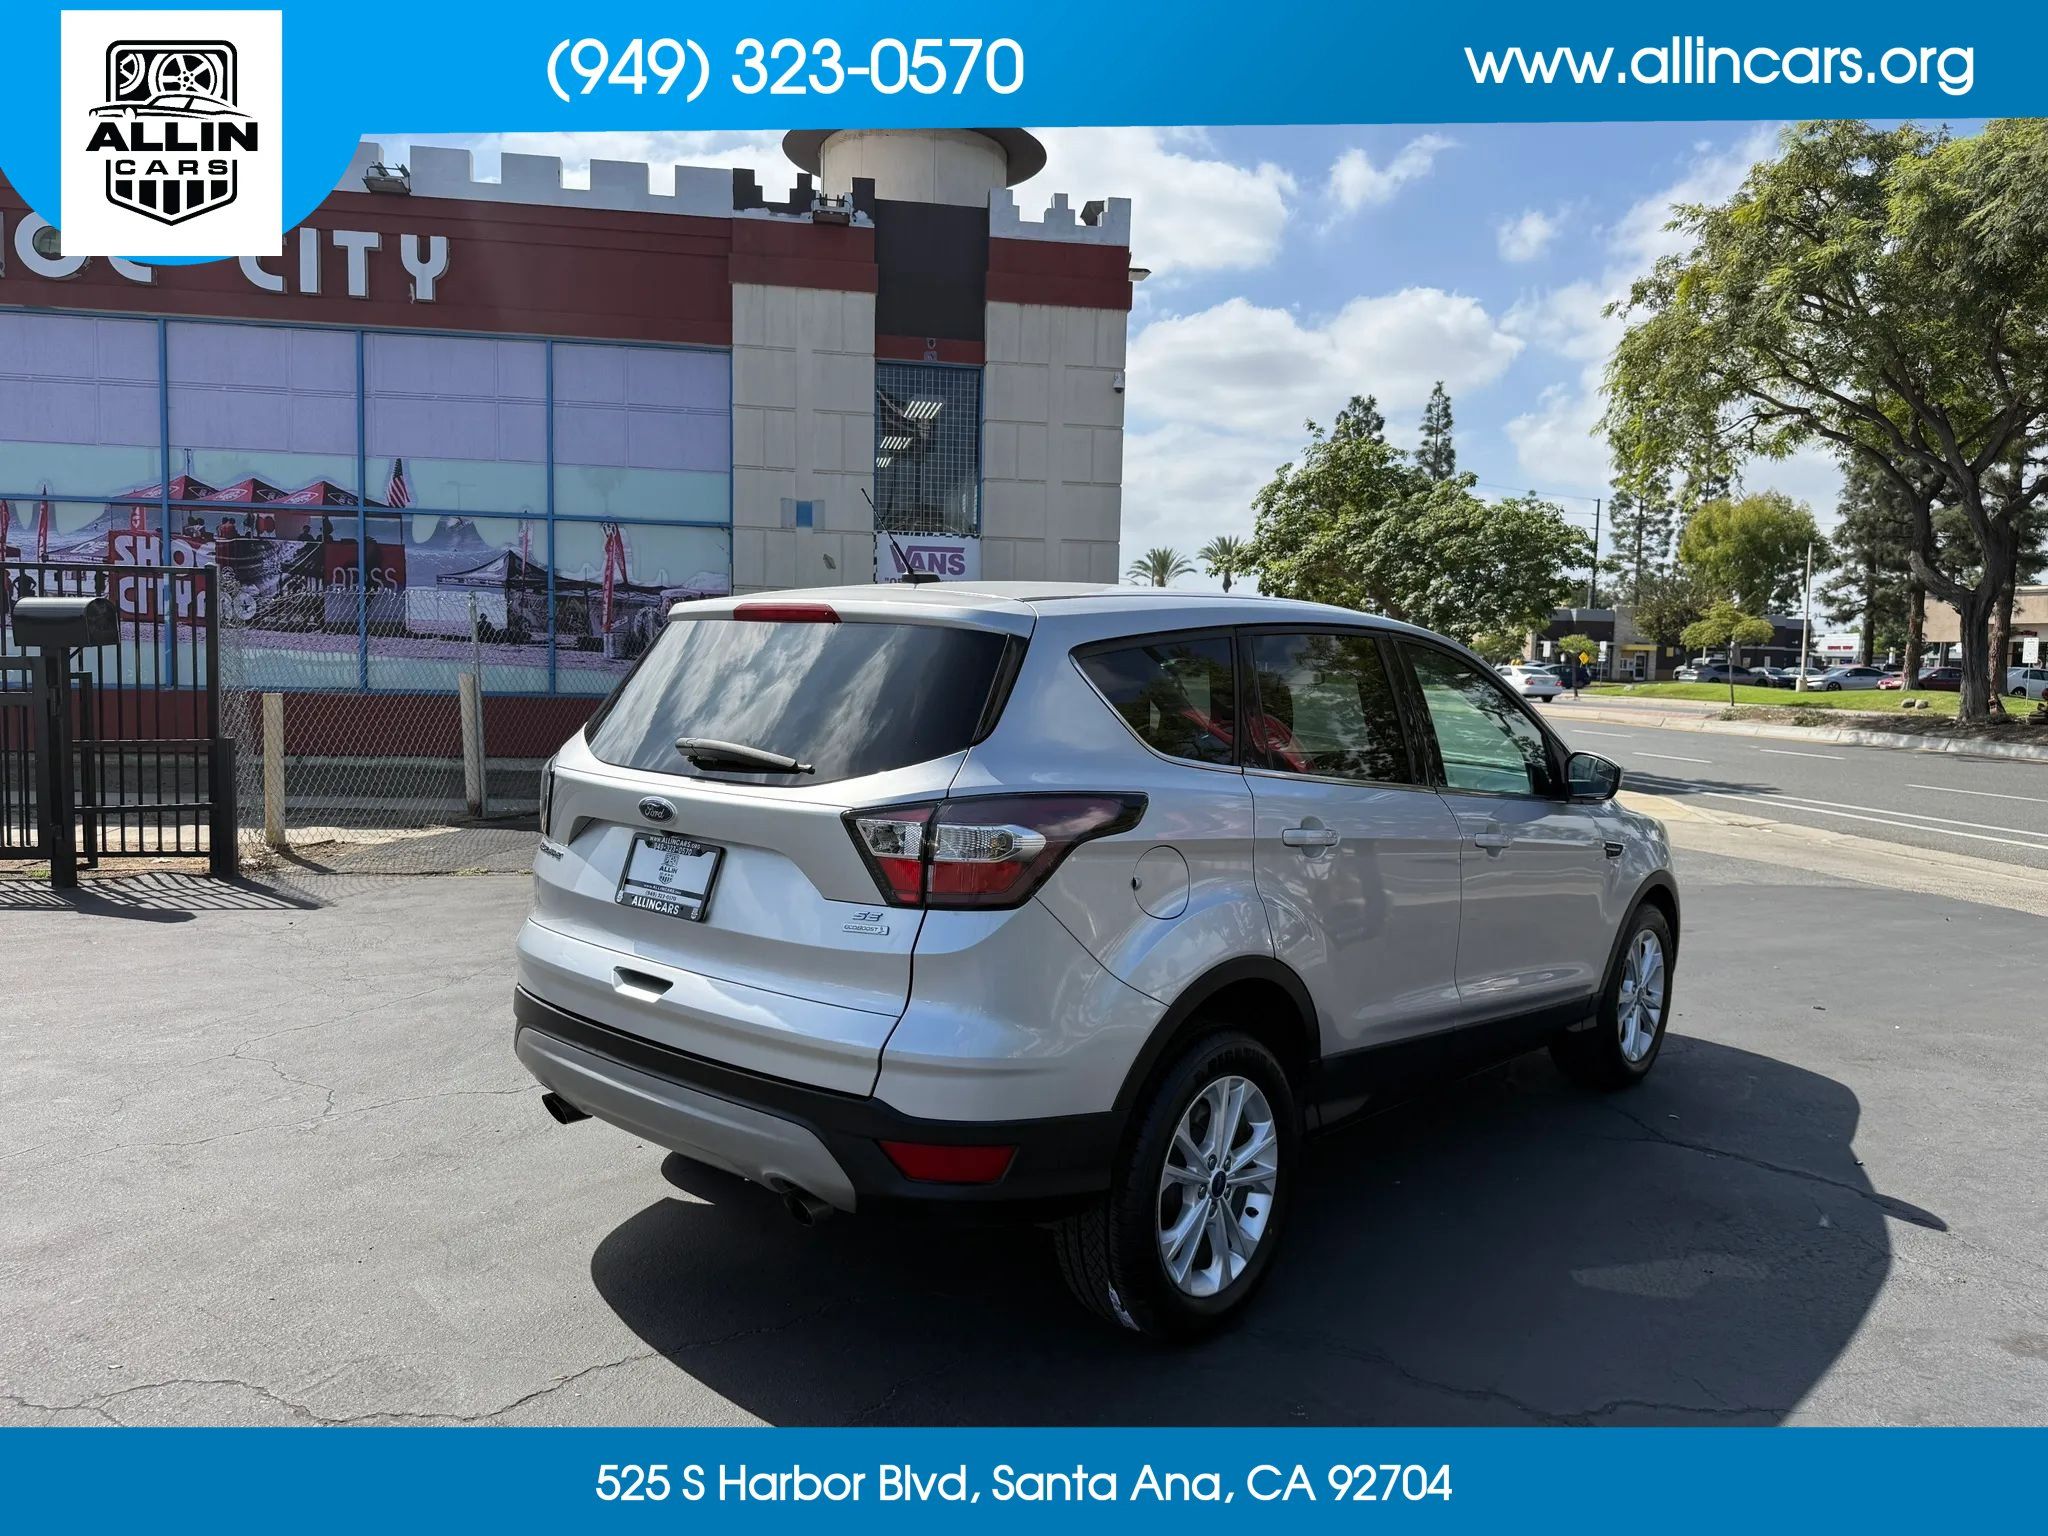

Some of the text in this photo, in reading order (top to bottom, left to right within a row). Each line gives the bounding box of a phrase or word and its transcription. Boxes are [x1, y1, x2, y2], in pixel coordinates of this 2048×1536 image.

[889, 544, 966, 576] VANS
[631, 895, 680, 915] ALLINCARS
[852, 911, 884, 922] SE
